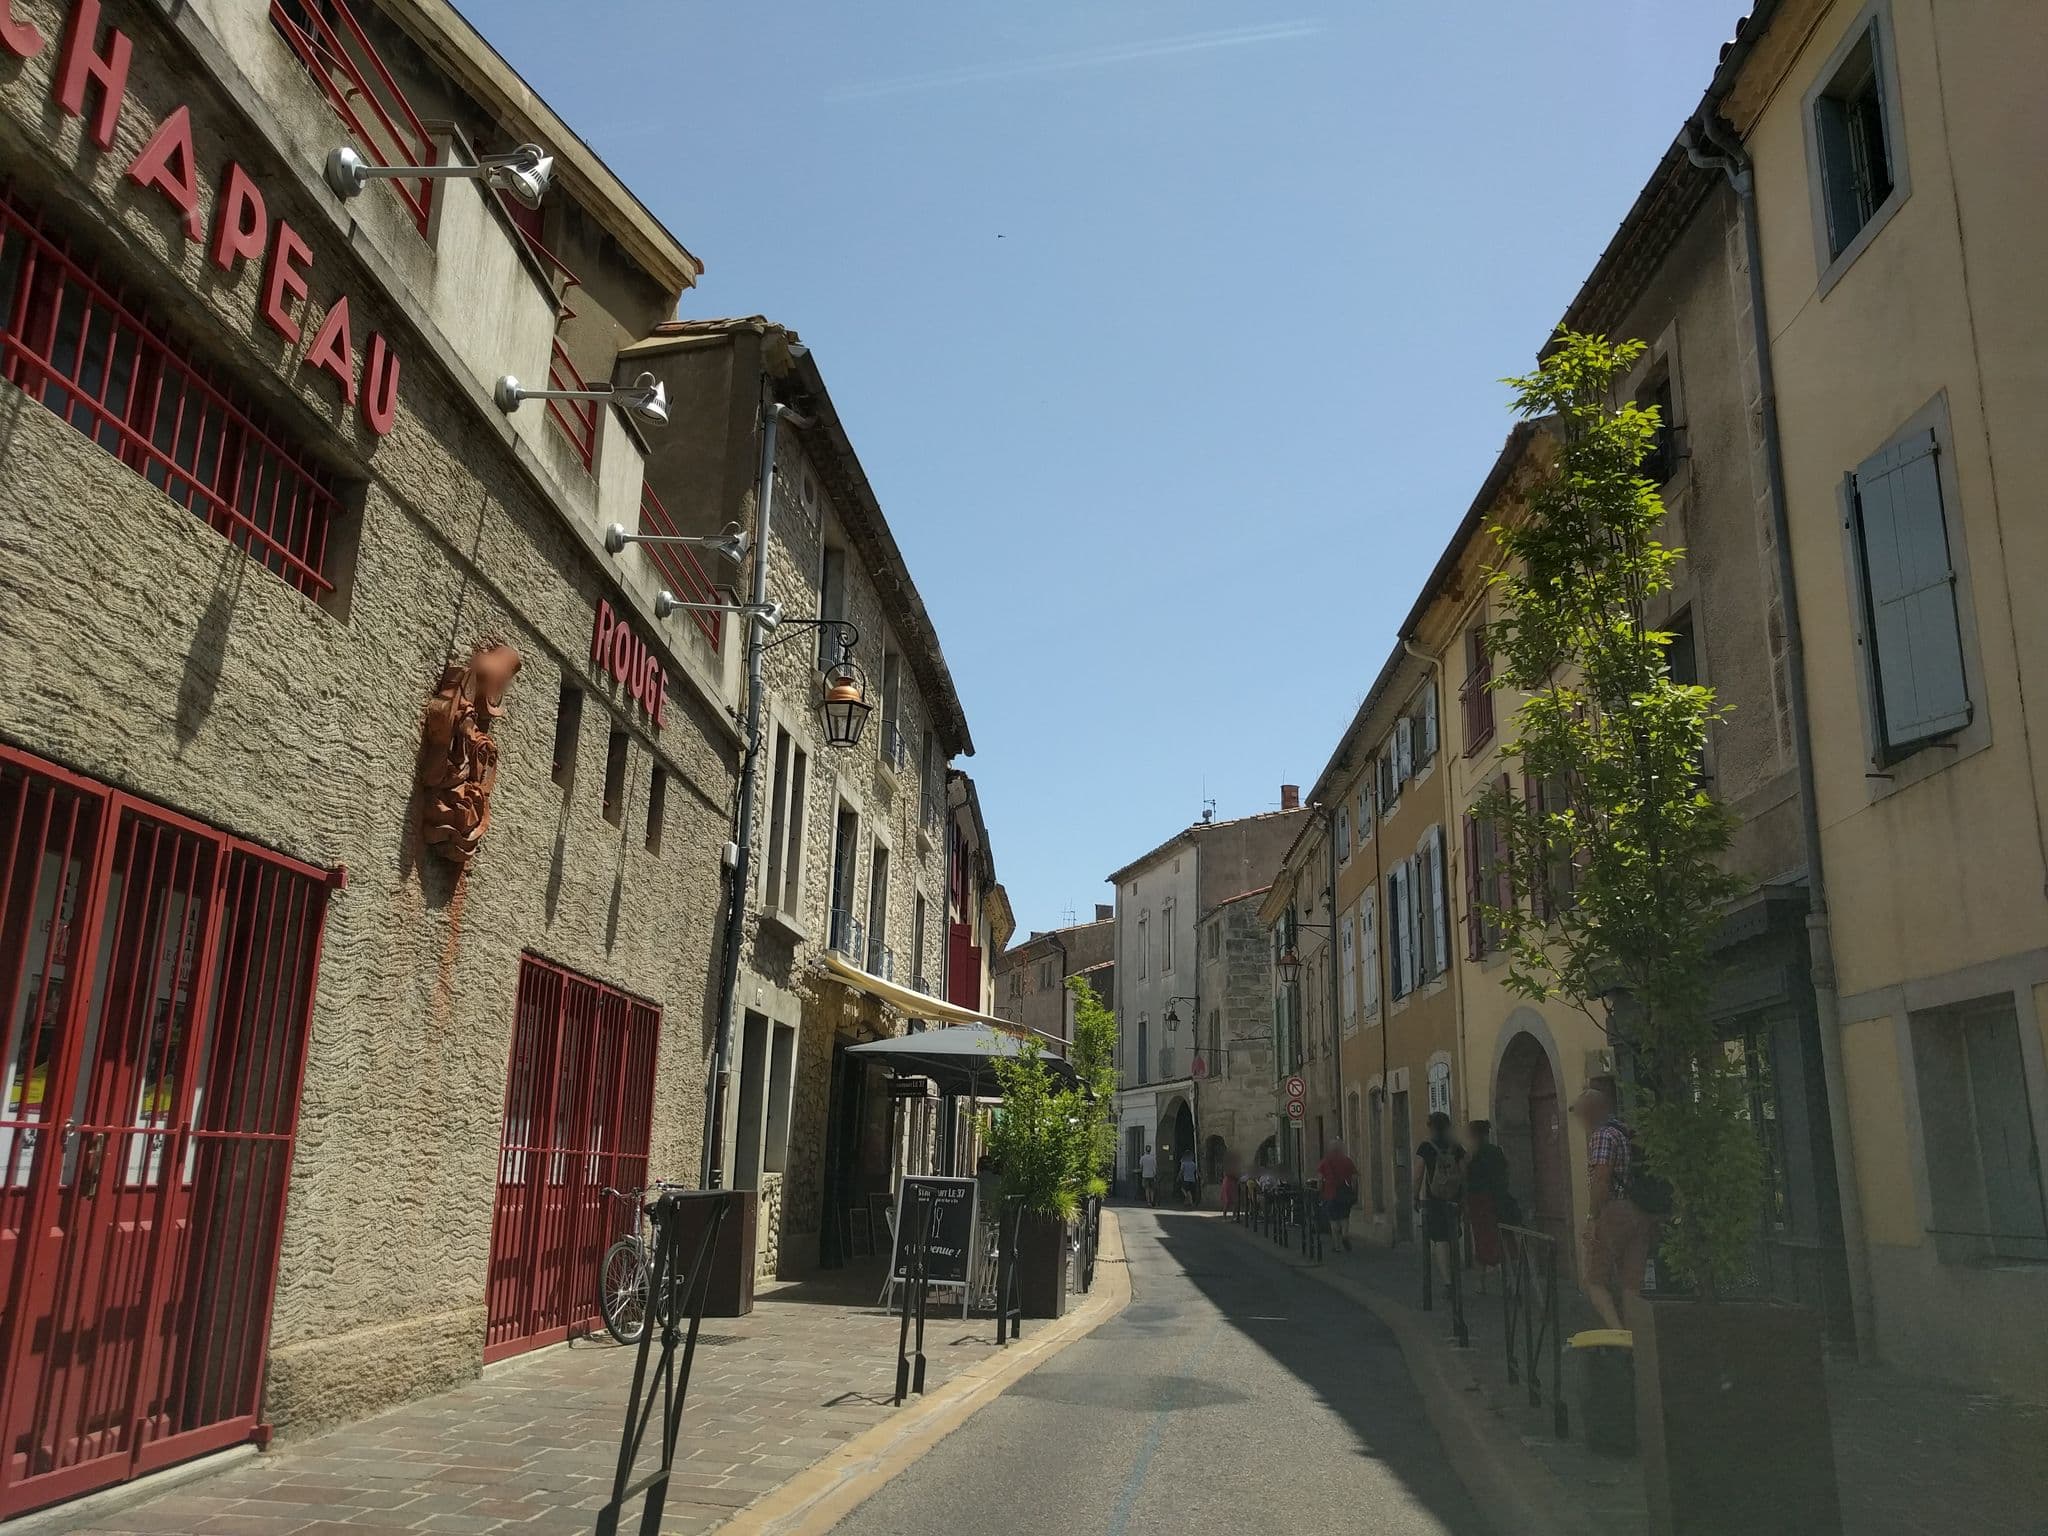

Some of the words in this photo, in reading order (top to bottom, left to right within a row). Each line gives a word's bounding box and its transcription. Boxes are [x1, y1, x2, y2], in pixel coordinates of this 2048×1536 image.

[590, 598, 669, 731] ROUGE
[1290, 1104, 1301, 1113] 30
[948, 1187, 957, 1198] LE
[957, 1188, 966, 1198] 37
